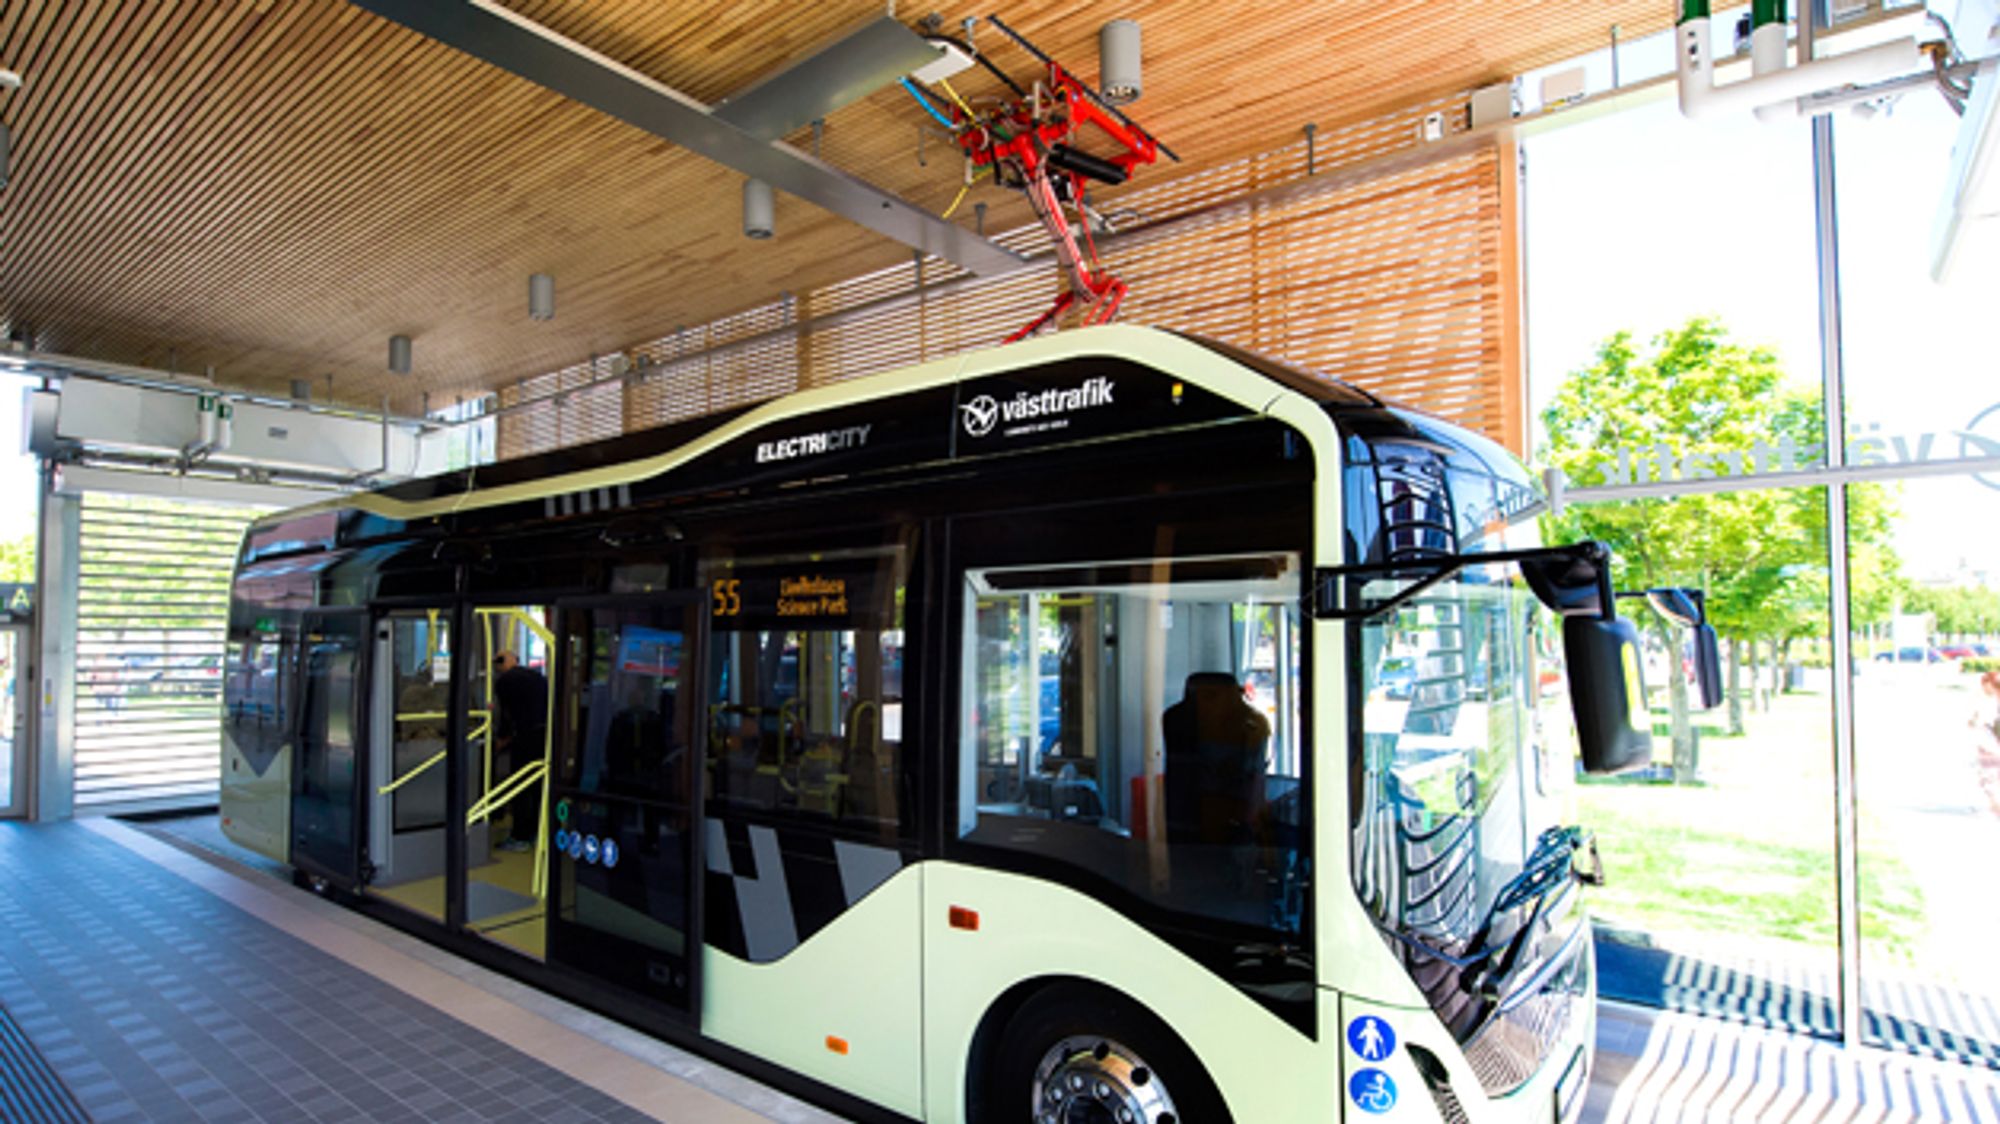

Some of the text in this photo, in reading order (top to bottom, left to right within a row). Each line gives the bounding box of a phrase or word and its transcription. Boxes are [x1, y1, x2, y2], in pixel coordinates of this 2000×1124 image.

[1002, 377, 1115, 421] västtrafik
[756, 424, 872, 463] ELECTRICITY
[10, 587, 30, 608] A
[713, 579, 740, 616] 55
[819, 597, 848, 616] Park
